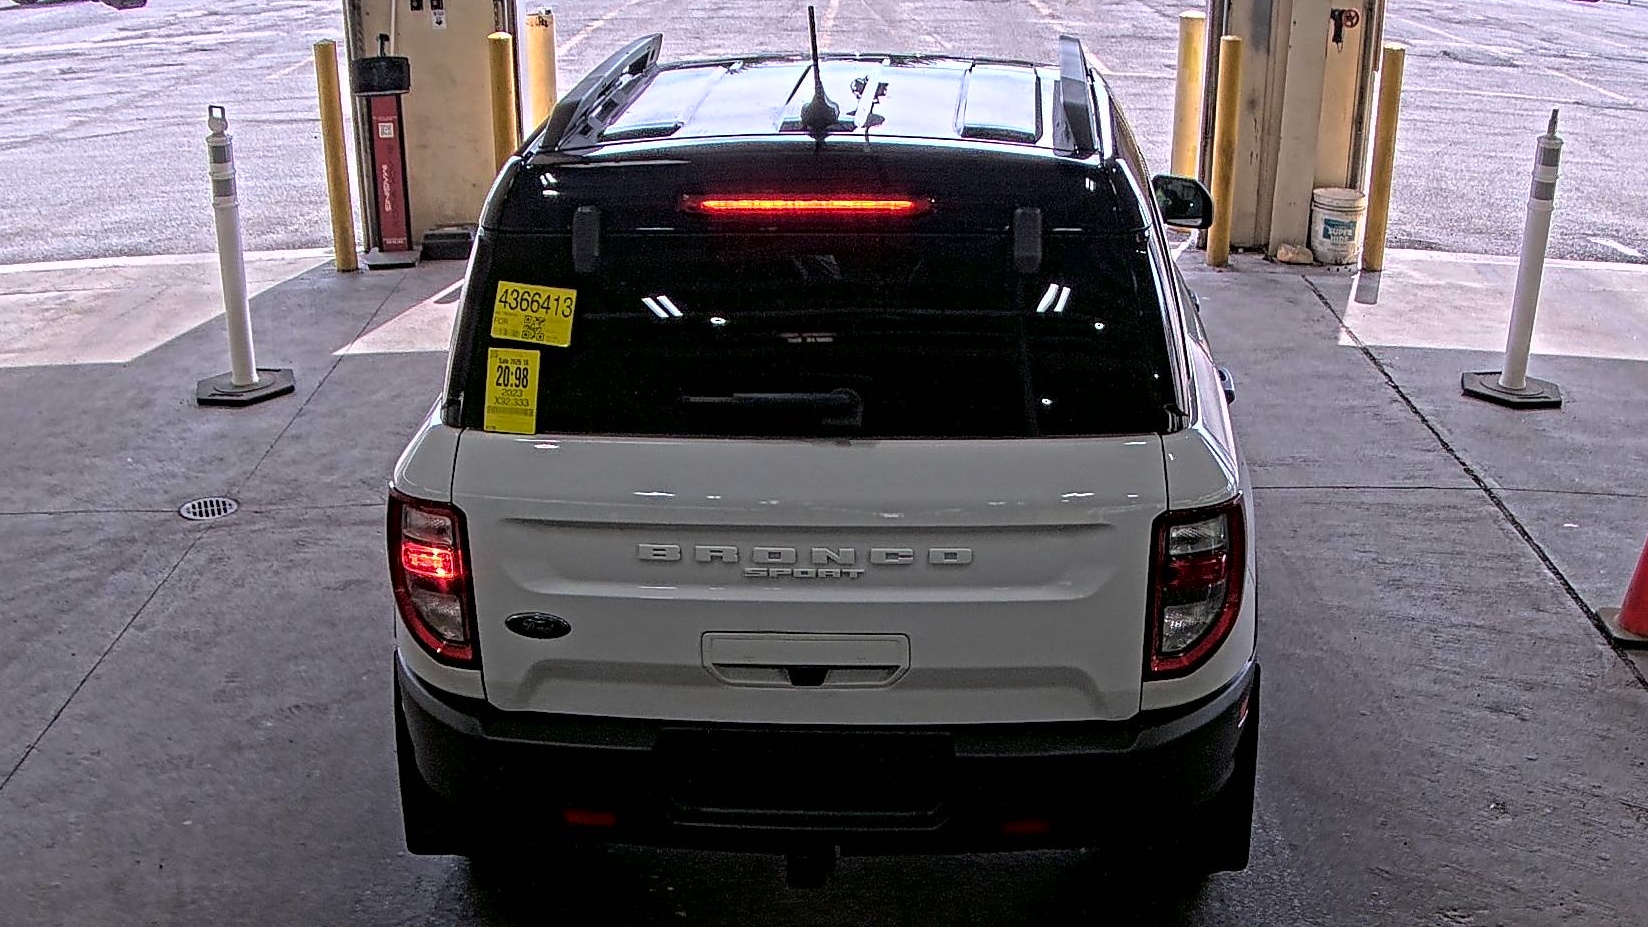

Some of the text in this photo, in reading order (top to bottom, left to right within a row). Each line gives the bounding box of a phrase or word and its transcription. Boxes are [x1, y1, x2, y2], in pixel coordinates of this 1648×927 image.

[499, 288, 573, 318] 4366413
[496, 365, 529, 388] 20:98
[501, 389, 523, 397] 2023
[638, 543, 974, 565] BRONCO
[743, 567, 866, 579] SPORT
